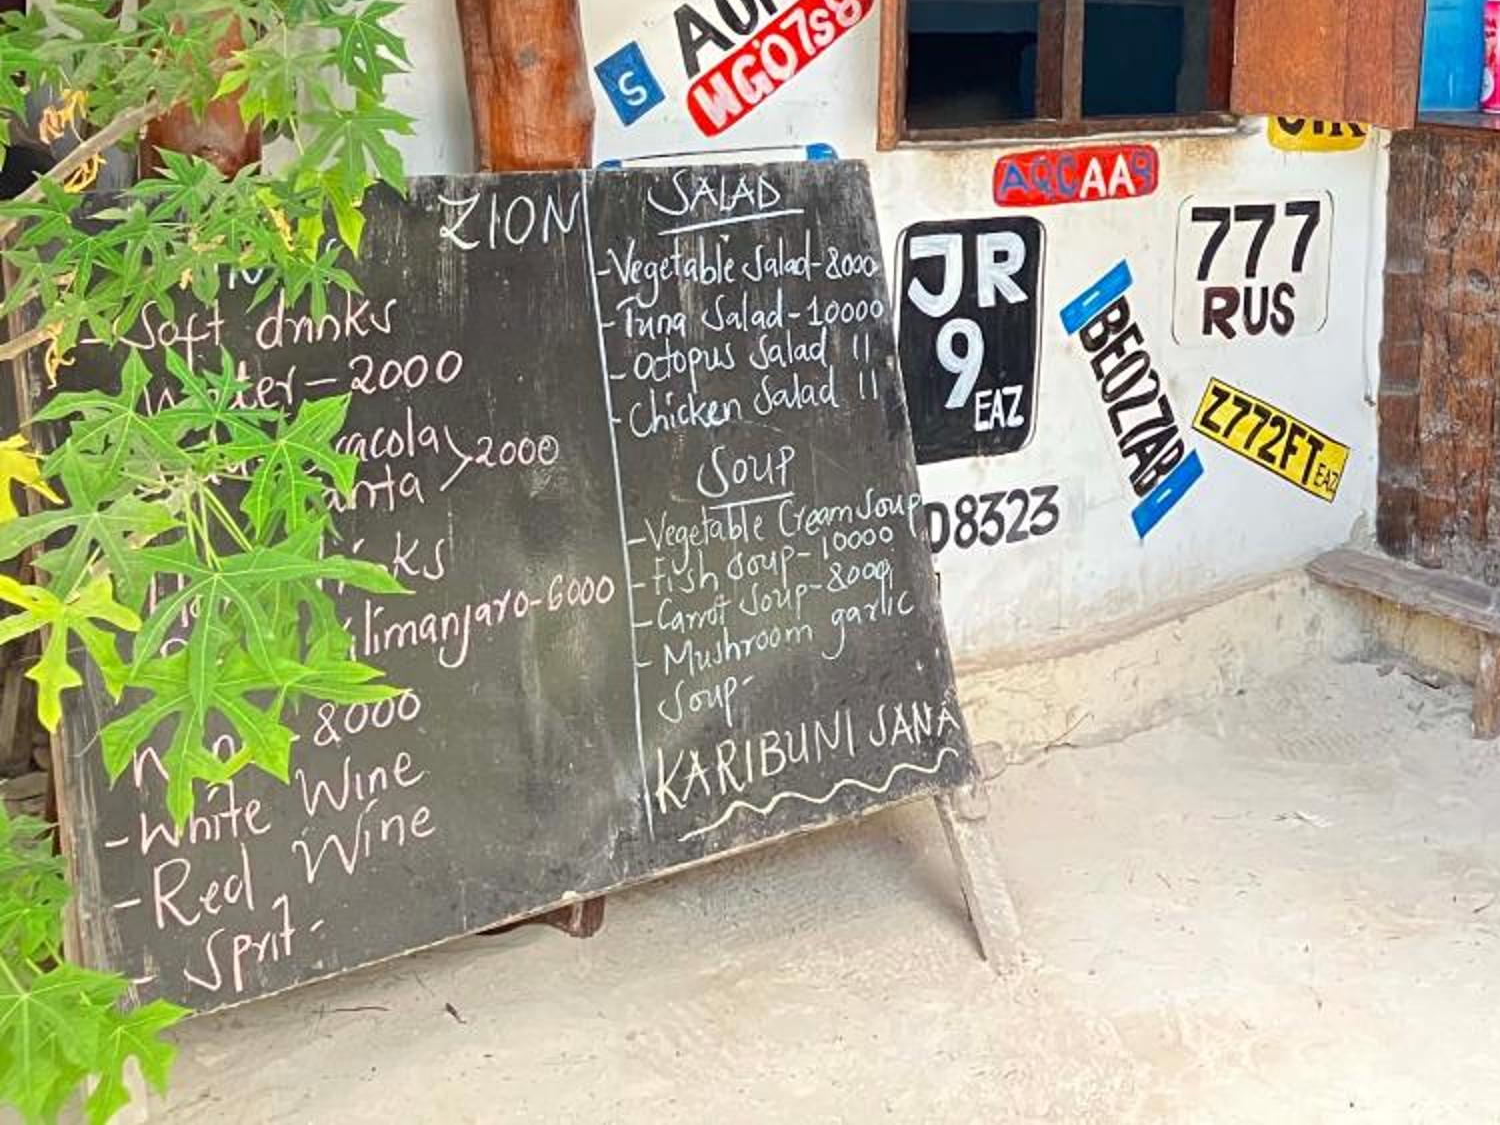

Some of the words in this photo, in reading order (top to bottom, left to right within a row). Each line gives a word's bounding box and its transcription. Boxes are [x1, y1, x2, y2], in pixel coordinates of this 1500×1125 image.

[619, 68, 647, 107] S
[438, 191, 582, 250] ZION
[648, 169, 782, 216] SALAD
[907, 231, 1028, 317] JR
[1190, 200, 1322, 282] 777
[1202, 281, 1296, 340] RUS
[935, 318, 986, 409] 9
[973, 385, 1025, 432] EAZ
[294, 750, 424, 818] Wine
[655, 707, 855, 814] KARIBUNI
[291, 799, 437, 885] Wine
